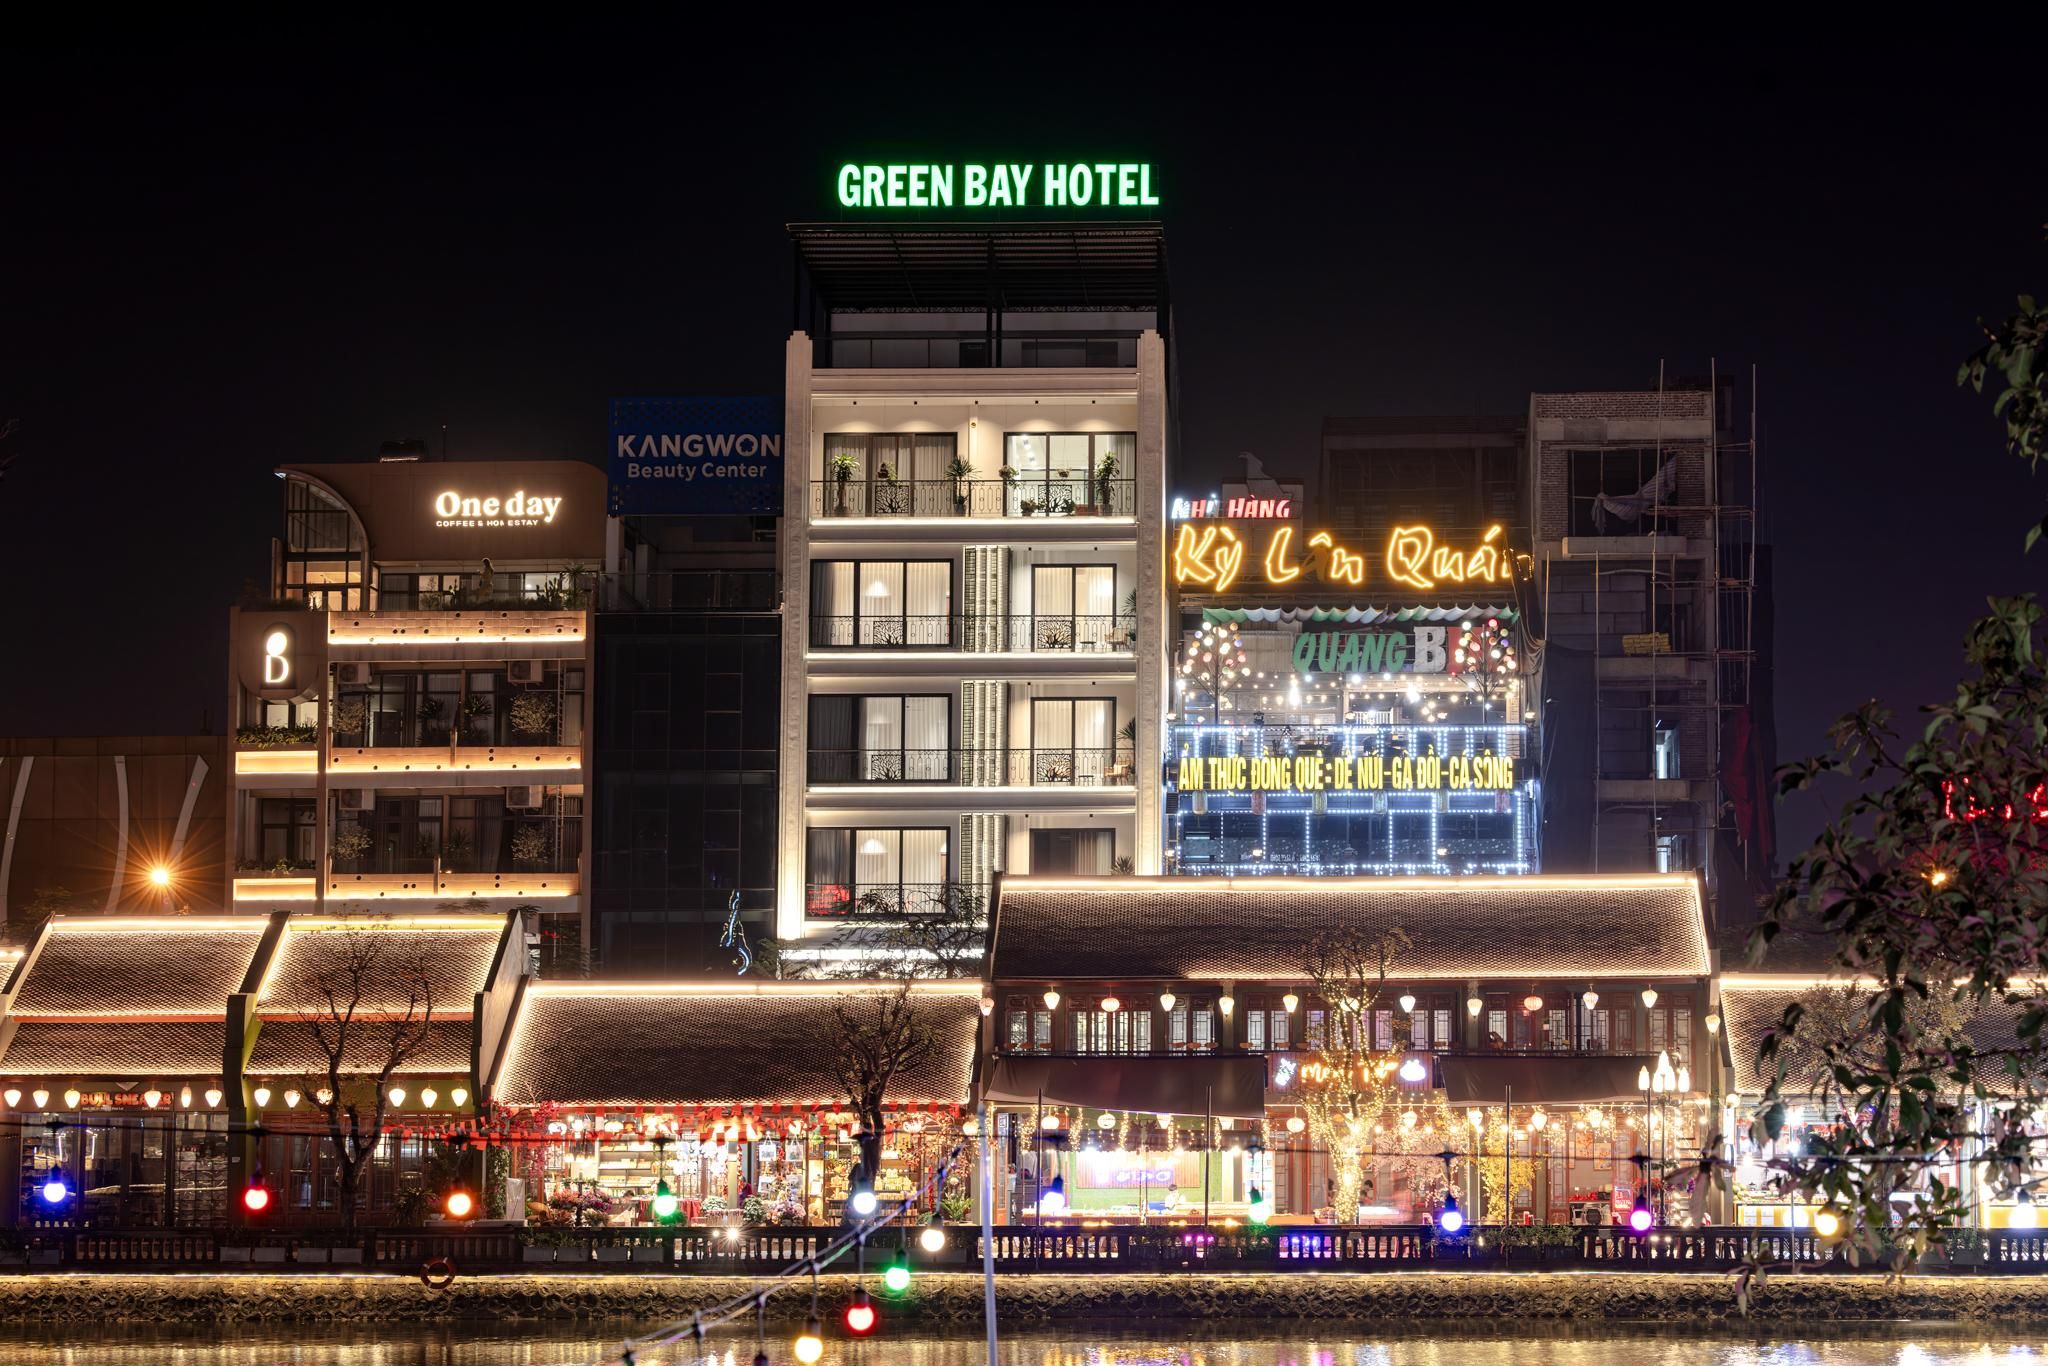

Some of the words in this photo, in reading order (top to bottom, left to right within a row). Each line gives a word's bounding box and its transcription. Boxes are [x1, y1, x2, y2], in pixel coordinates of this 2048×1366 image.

[838, 163, 953, 207] GREEN
[965, 163, 1033, 206] BAY
[1044, 163, 1160, 206] HOTEL
[617, 433, 781, 458] KANGWON
[627, 462, 697, 481] Beauty
[701, 462, 767, 478] Center
[435, 491, 500, 517] One
[505, 490, 562, 523] day
[1227, 494, 1290, 518] HÀNG
[1175, 524, 1242, 592] Kỳ
[1292, 631, 1407, 673] QUANG
[1472, 748, 1513, 790] SÔNG
[81, 1093, 113, 1106] BULL
[114, 1092, 171, 1106] SNEAR
